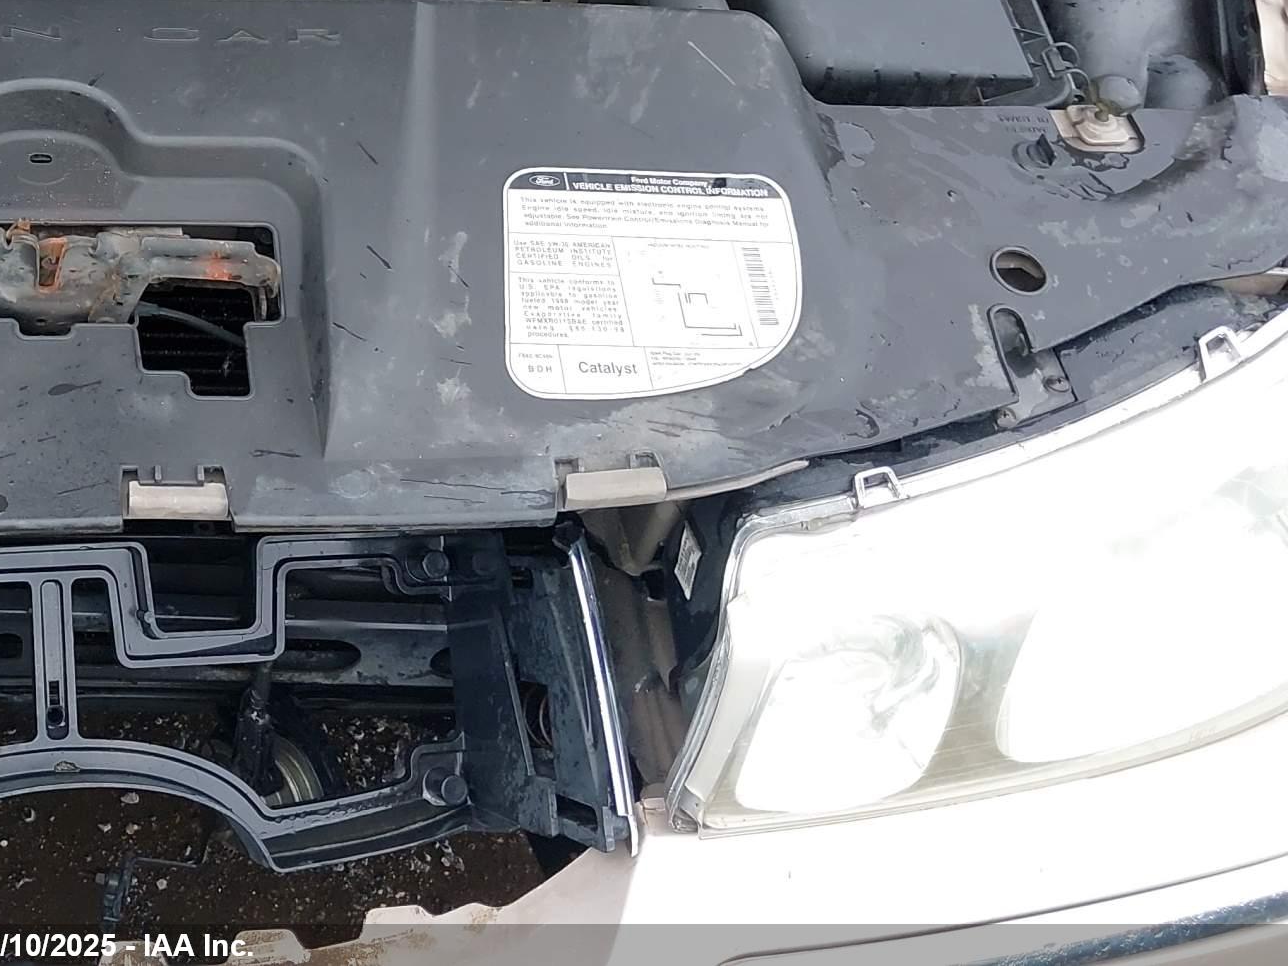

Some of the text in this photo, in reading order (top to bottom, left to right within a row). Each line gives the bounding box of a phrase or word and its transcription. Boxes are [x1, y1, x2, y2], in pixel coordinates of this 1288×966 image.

[144, 27, 341, 43] CAR
[535, 176, 555, 185] Ford
[631, 176, 708, 187] Ford Motor Company
[573, 182, 769, 198] VEHICLE EMISSION CONTROL INFORMATION
[521, 204, 550, 212] Engine
[580, 199, 615, 207] equipped
[578, 361, 638, 377] Catalyst
